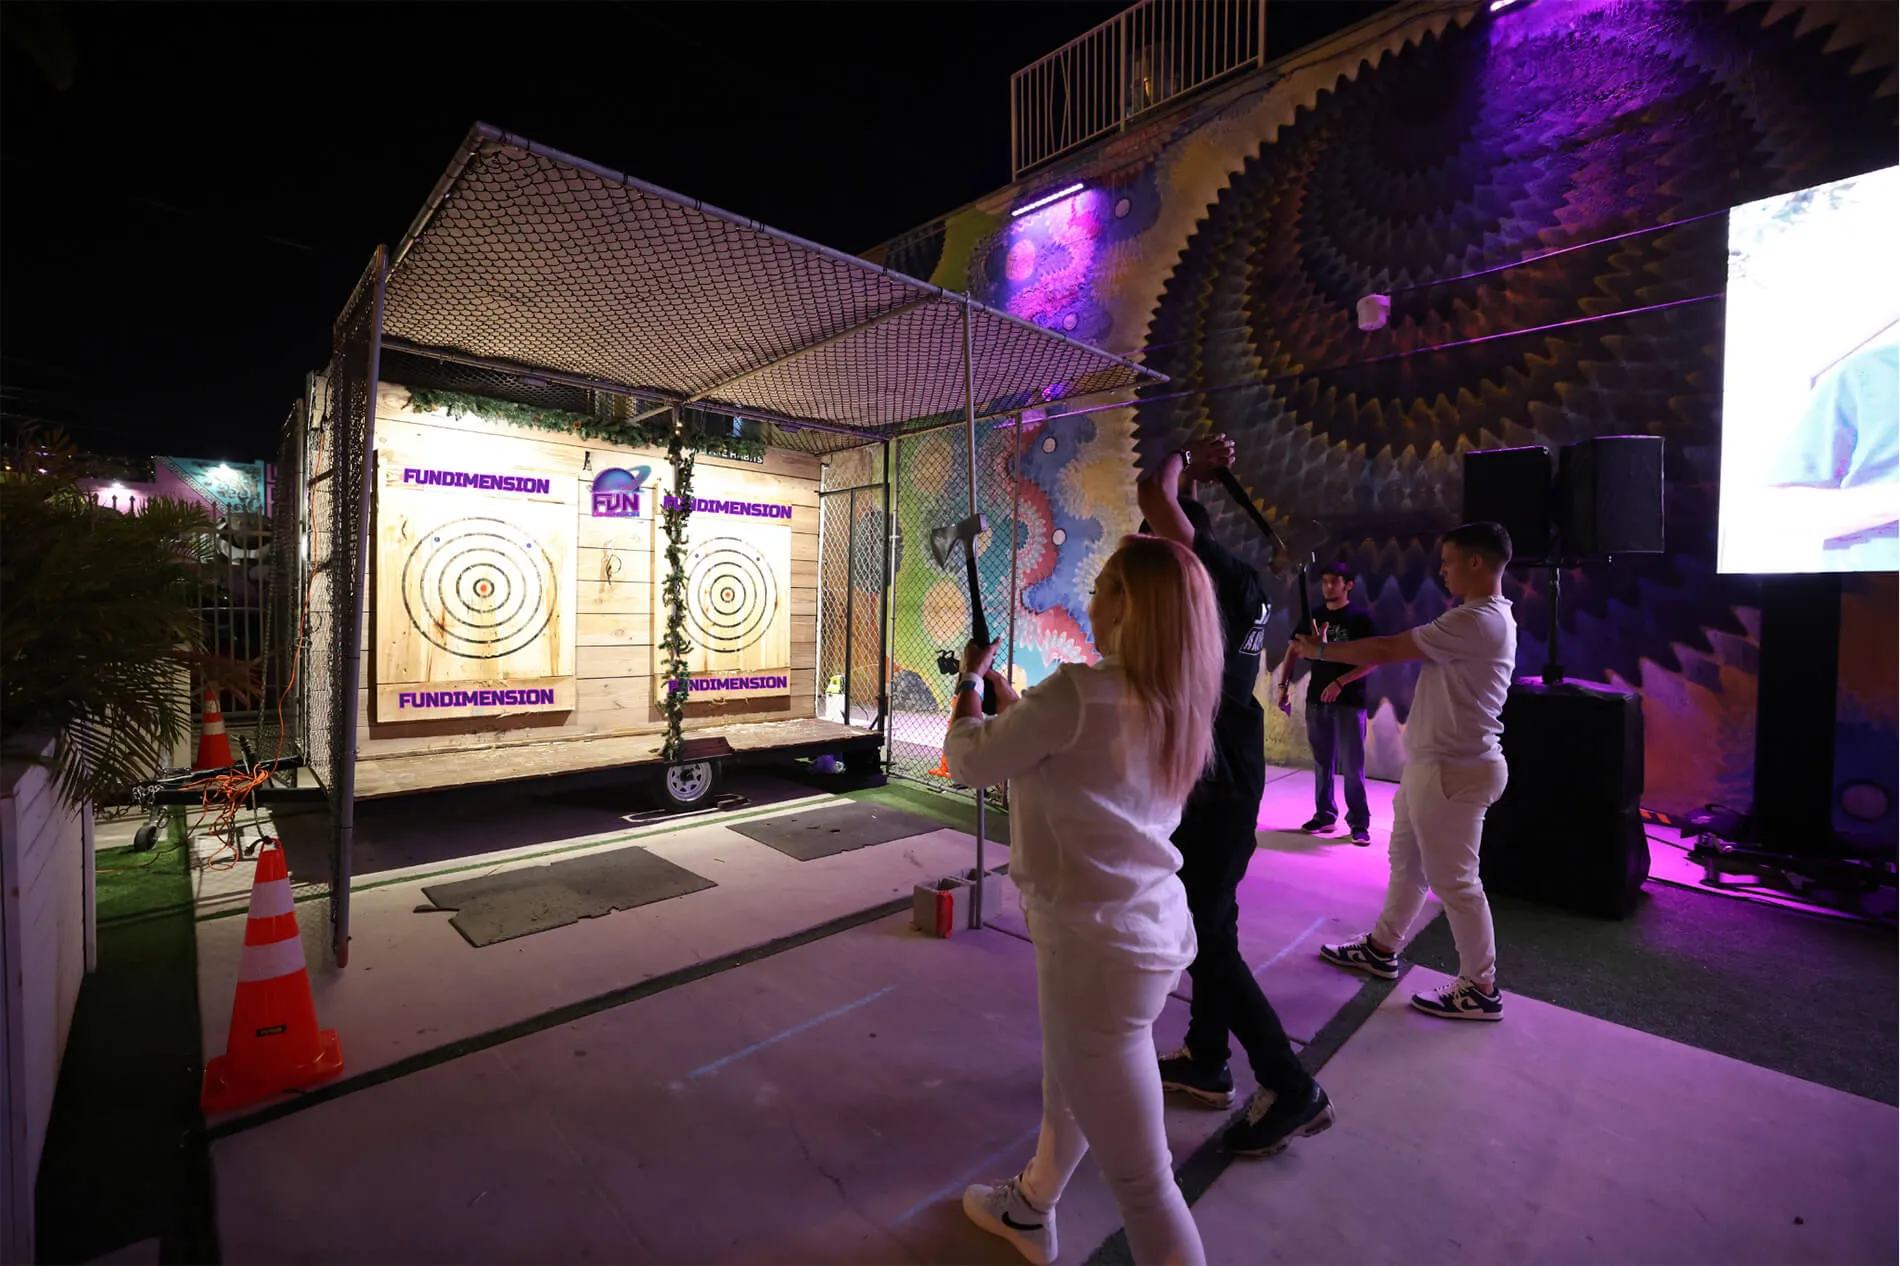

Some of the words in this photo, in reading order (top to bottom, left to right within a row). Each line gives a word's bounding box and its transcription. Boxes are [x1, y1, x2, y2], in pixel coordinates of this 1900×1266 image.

[403, 467, 550, 494] FUNDIMENSION
[592, 491, 640, 511] FUN
[668, 675, 787, 693] FNDIMENSION
[399, 688, 554, 708] FUNDIMENSION
